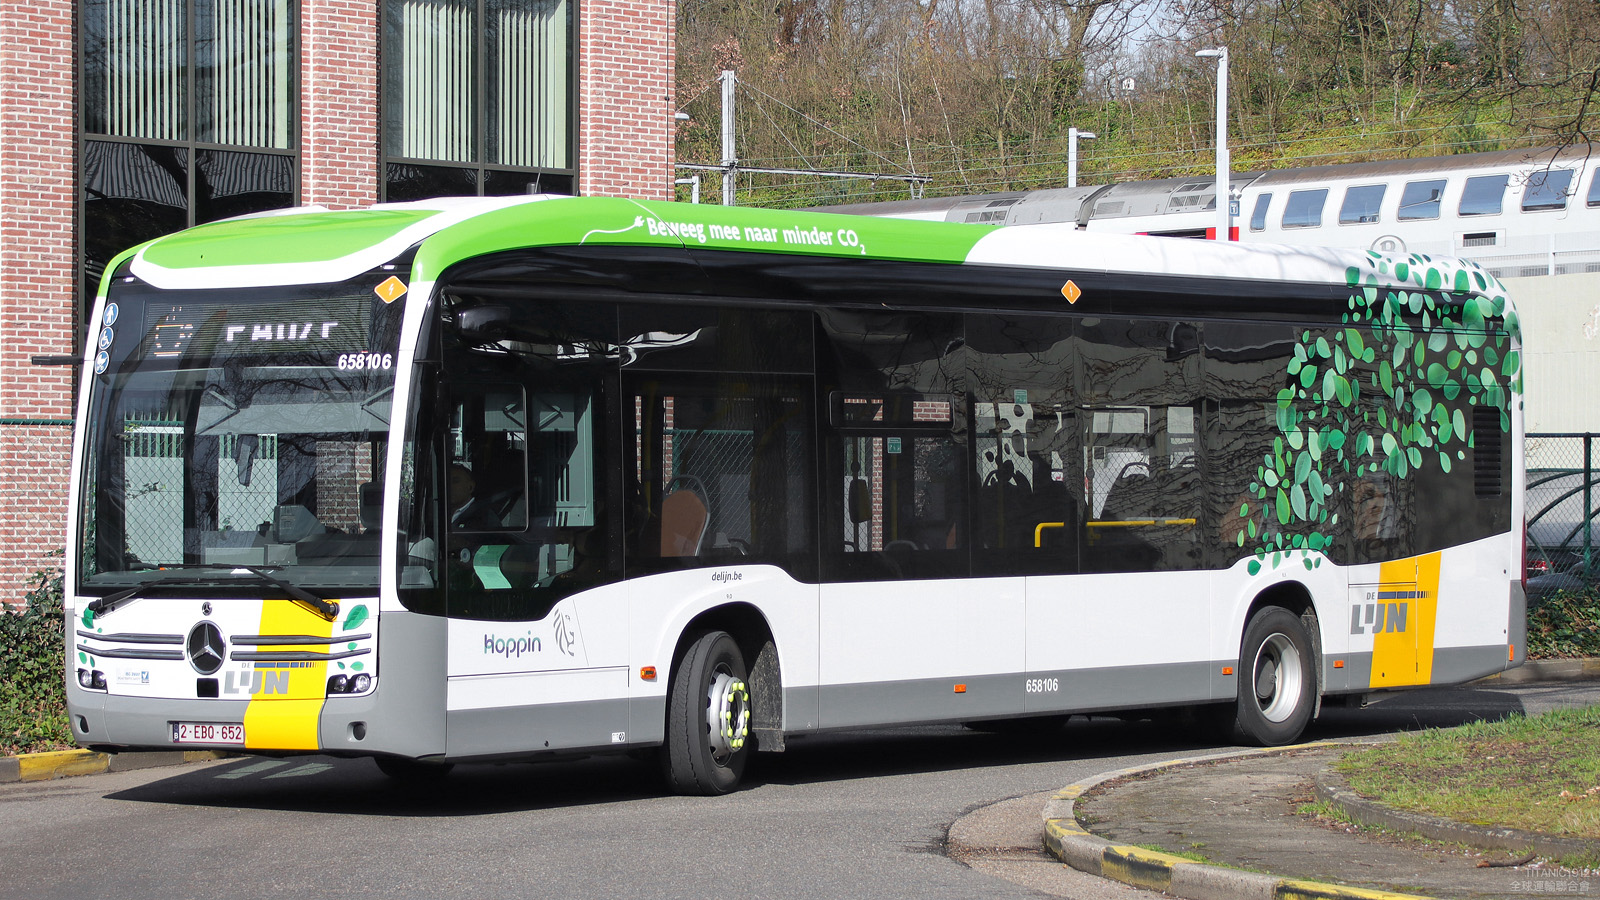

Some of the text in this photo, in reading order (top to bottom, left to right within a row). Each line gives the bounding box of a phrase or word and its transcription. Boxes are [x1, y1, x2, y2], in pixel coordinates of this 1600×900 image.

[647, 217, 706, 243] Beweeg
[709, 225, 741, 240] mee
[744, 227, 778, 242] naar
[783, 225, 833, 245] minder
[338, 353, 392, 370] 658106
[711, 571, 742, 583] delijn.be
[1366, 592, 1375, 600] DE
[1350, 603, 1408, 634] LIJN
[224, 671, 290, 694] LIJN
[1026, 678, 1059, 692] 658106
